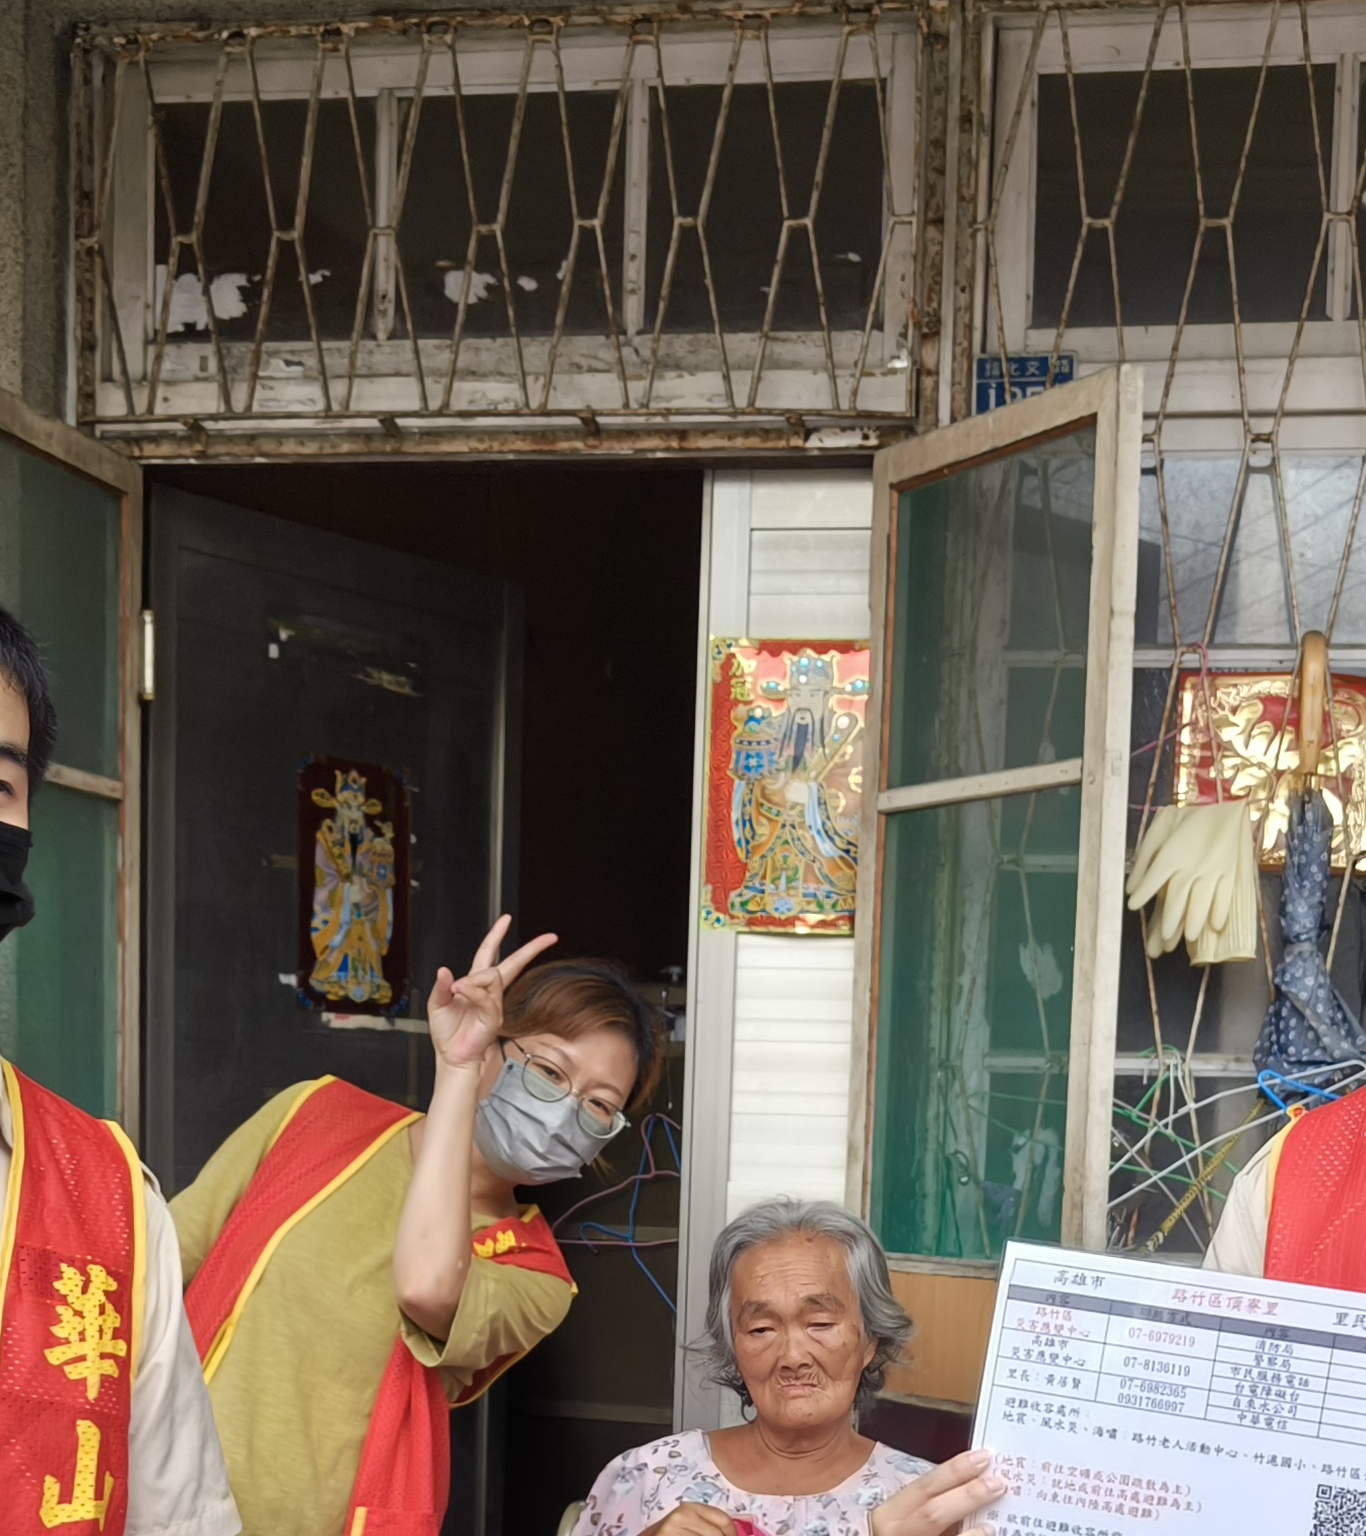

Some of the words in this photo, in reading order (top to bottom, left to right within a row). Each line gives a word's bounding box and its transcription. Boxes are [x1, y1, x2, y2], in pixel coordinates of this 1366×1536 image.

[1053, 1269, 1107, 1290] 高雄市
[1170, 1287, 1280, 1317] 路竹區頂寮里
[1035, 1306, 1073, 1322] 路竹區
[1015, 1317, 1092, 1339] 災害應變中心
[1031, 1335, 1070, 1350] 高雄市
[1255, 1339, 1294, 1357] 消防局
[1010, 1346, 1088, 1368] 災害應變中心
[1252, 1354, 1292, 1372] 警察局
[1230, 1366, 1311, 1389] 市民服務電話
[39, 1263, 127, 1532] 華山
[1231, 1396, 1299, 1418] 自來水公司
[1236, 1411, 1290, 1431] 中華電信
[1005, 1484, 1161, 1522] 嘯：向東往內陸高處避難)
